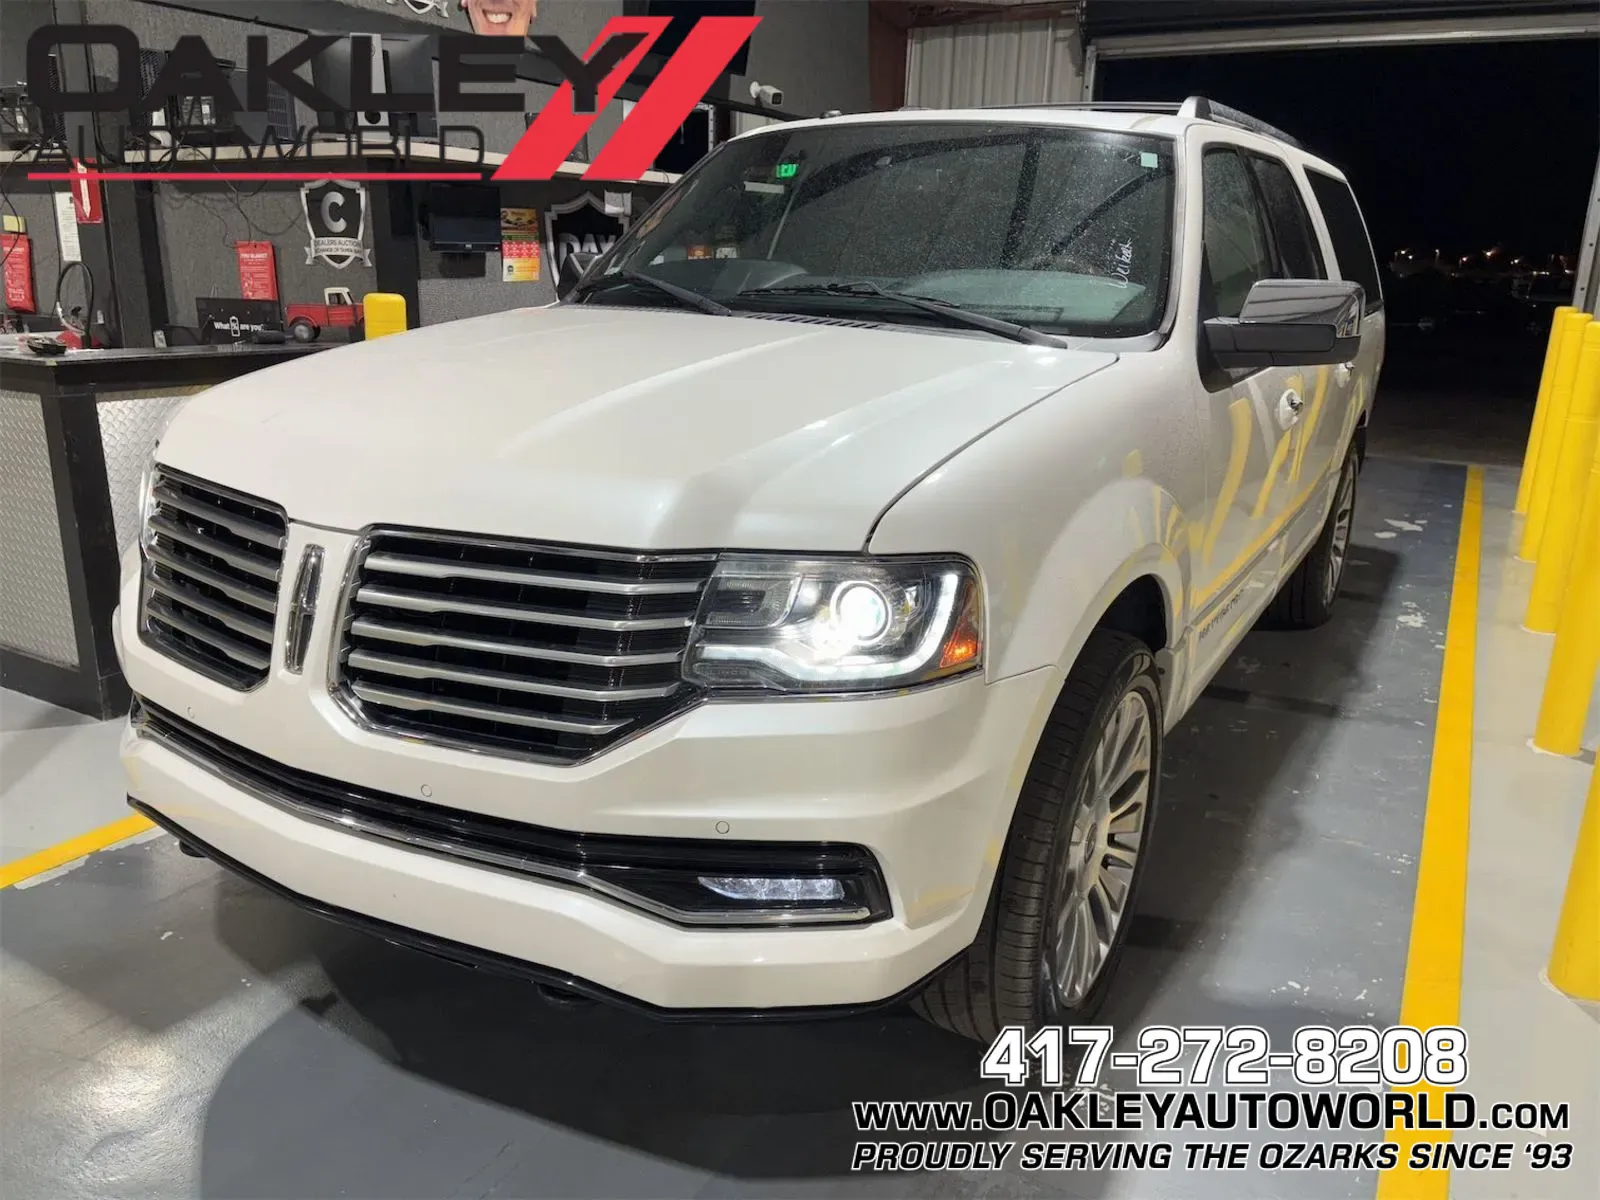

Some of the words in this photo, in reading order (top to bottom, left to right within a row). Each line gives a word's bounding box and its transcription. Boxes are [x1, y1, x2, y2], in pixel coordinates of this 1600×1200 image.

[321, 191, 347, 233] C
[213, 321, 230, 330] What
[240, 323, 250, 331] are
